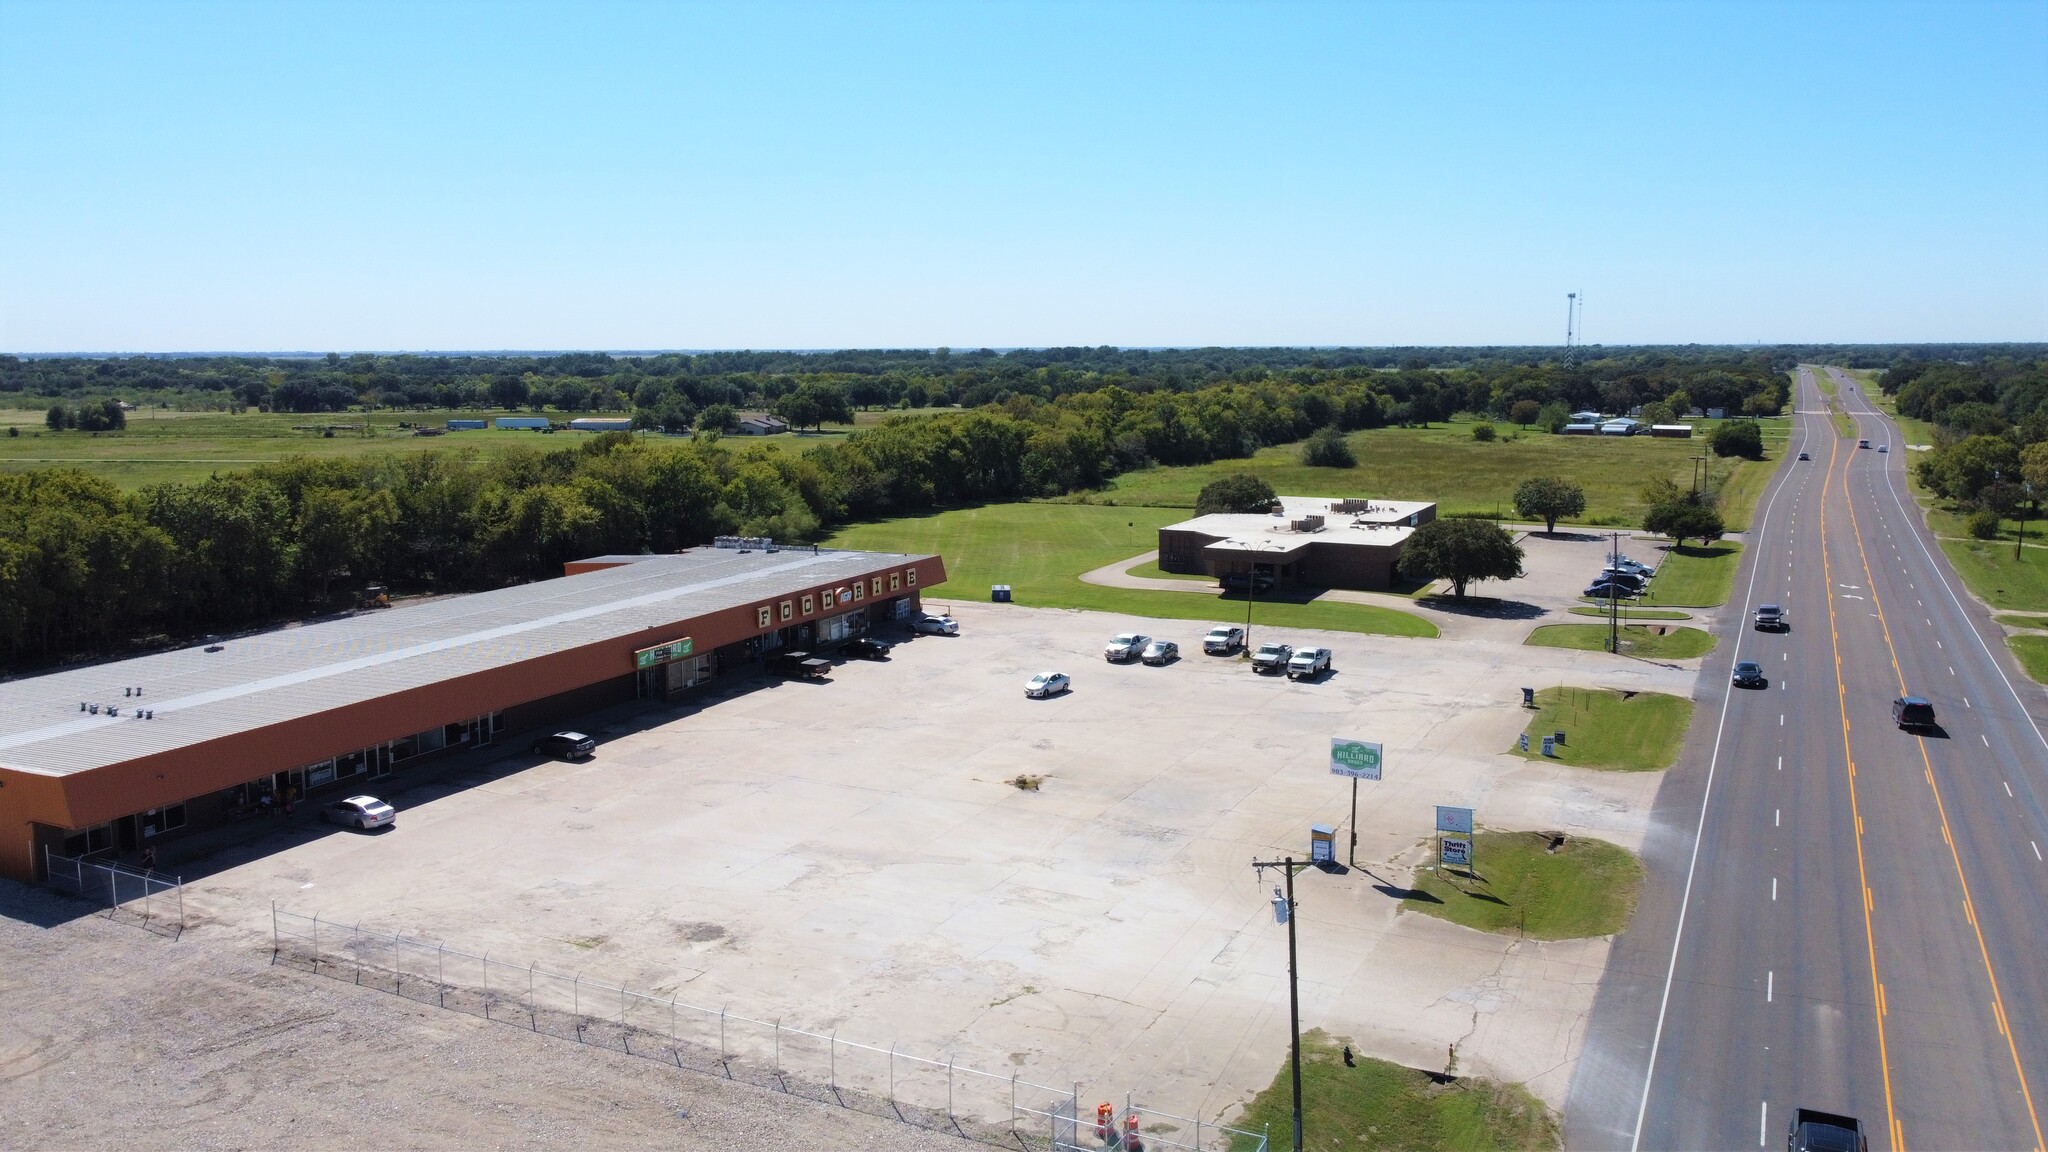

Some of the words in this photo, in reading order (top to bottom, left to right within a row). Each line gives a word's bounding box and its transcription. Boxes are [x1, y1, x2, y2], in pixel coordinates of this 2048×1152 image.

[761, 592, 833, 625] FOOD
[856, 572, 915, 599] RITE
[1337, 750, 1375, 764] HILLIARD
[1444, 840, 1466, 848] Thrift
[1444, 846, 1466, 855] Store
